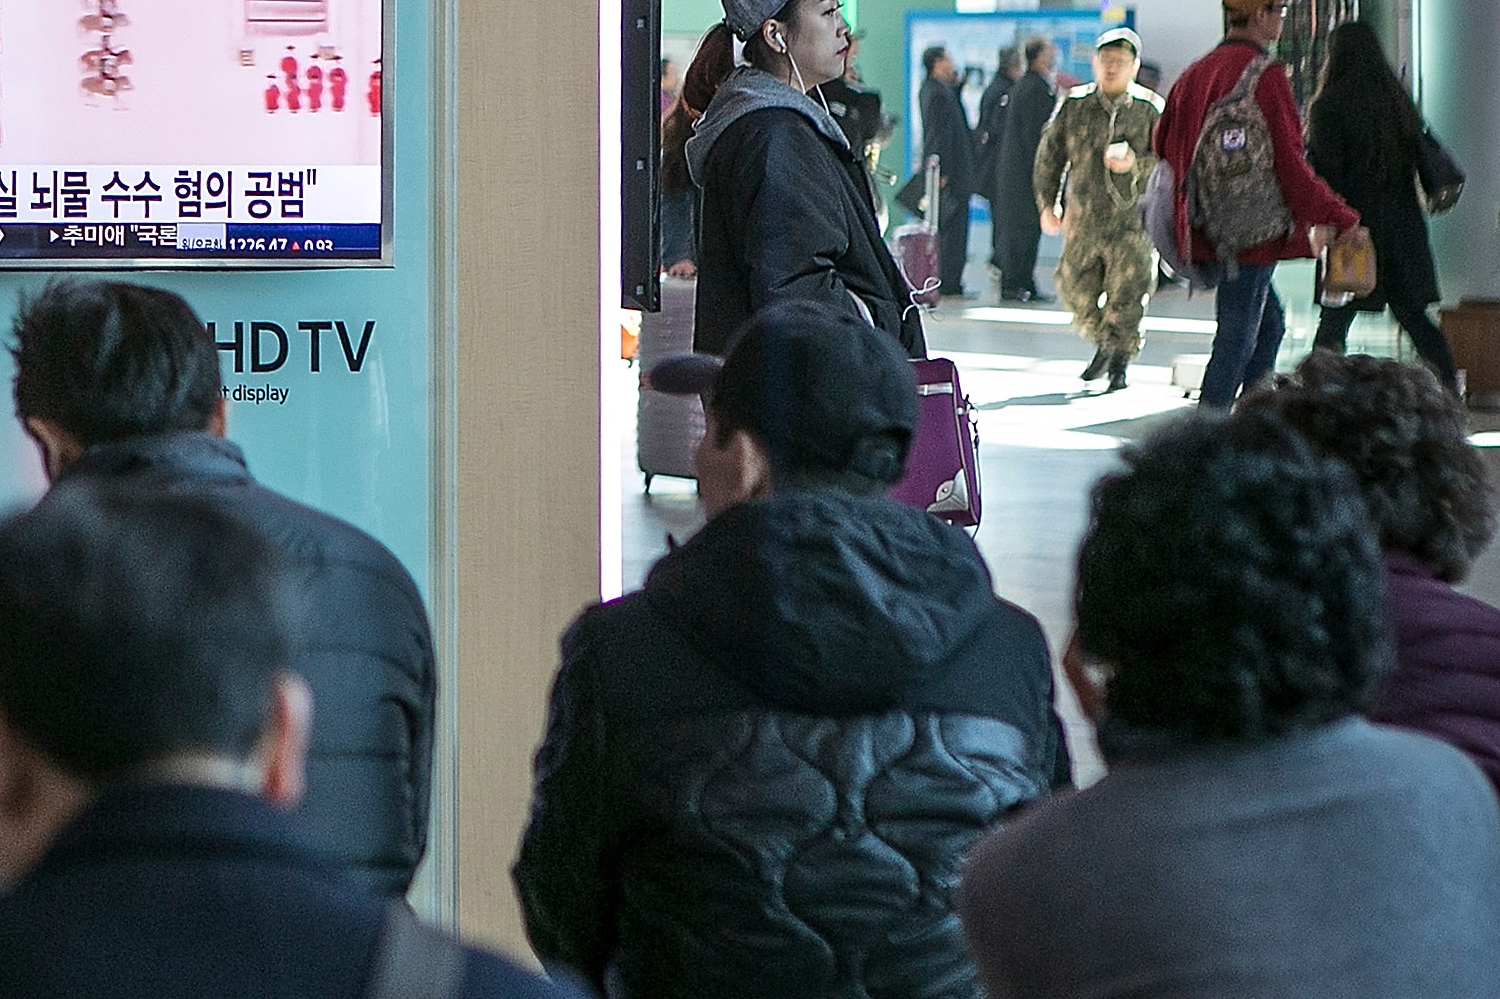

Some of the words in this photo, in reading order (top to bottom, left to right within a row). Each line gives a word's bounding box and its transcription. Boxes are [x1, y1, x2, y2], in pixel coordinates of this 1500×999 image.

[31, 169, 90, 219] 뇌물
[102, 170, 163, 219] 수수
[174, 168, 233, 219] 혐의
[244, 168, 317, 219] 공범"
[61, 226, 125, 247] 추미애
[298, 321, 376, 373] TV
[232, 384, 289, 404] display
